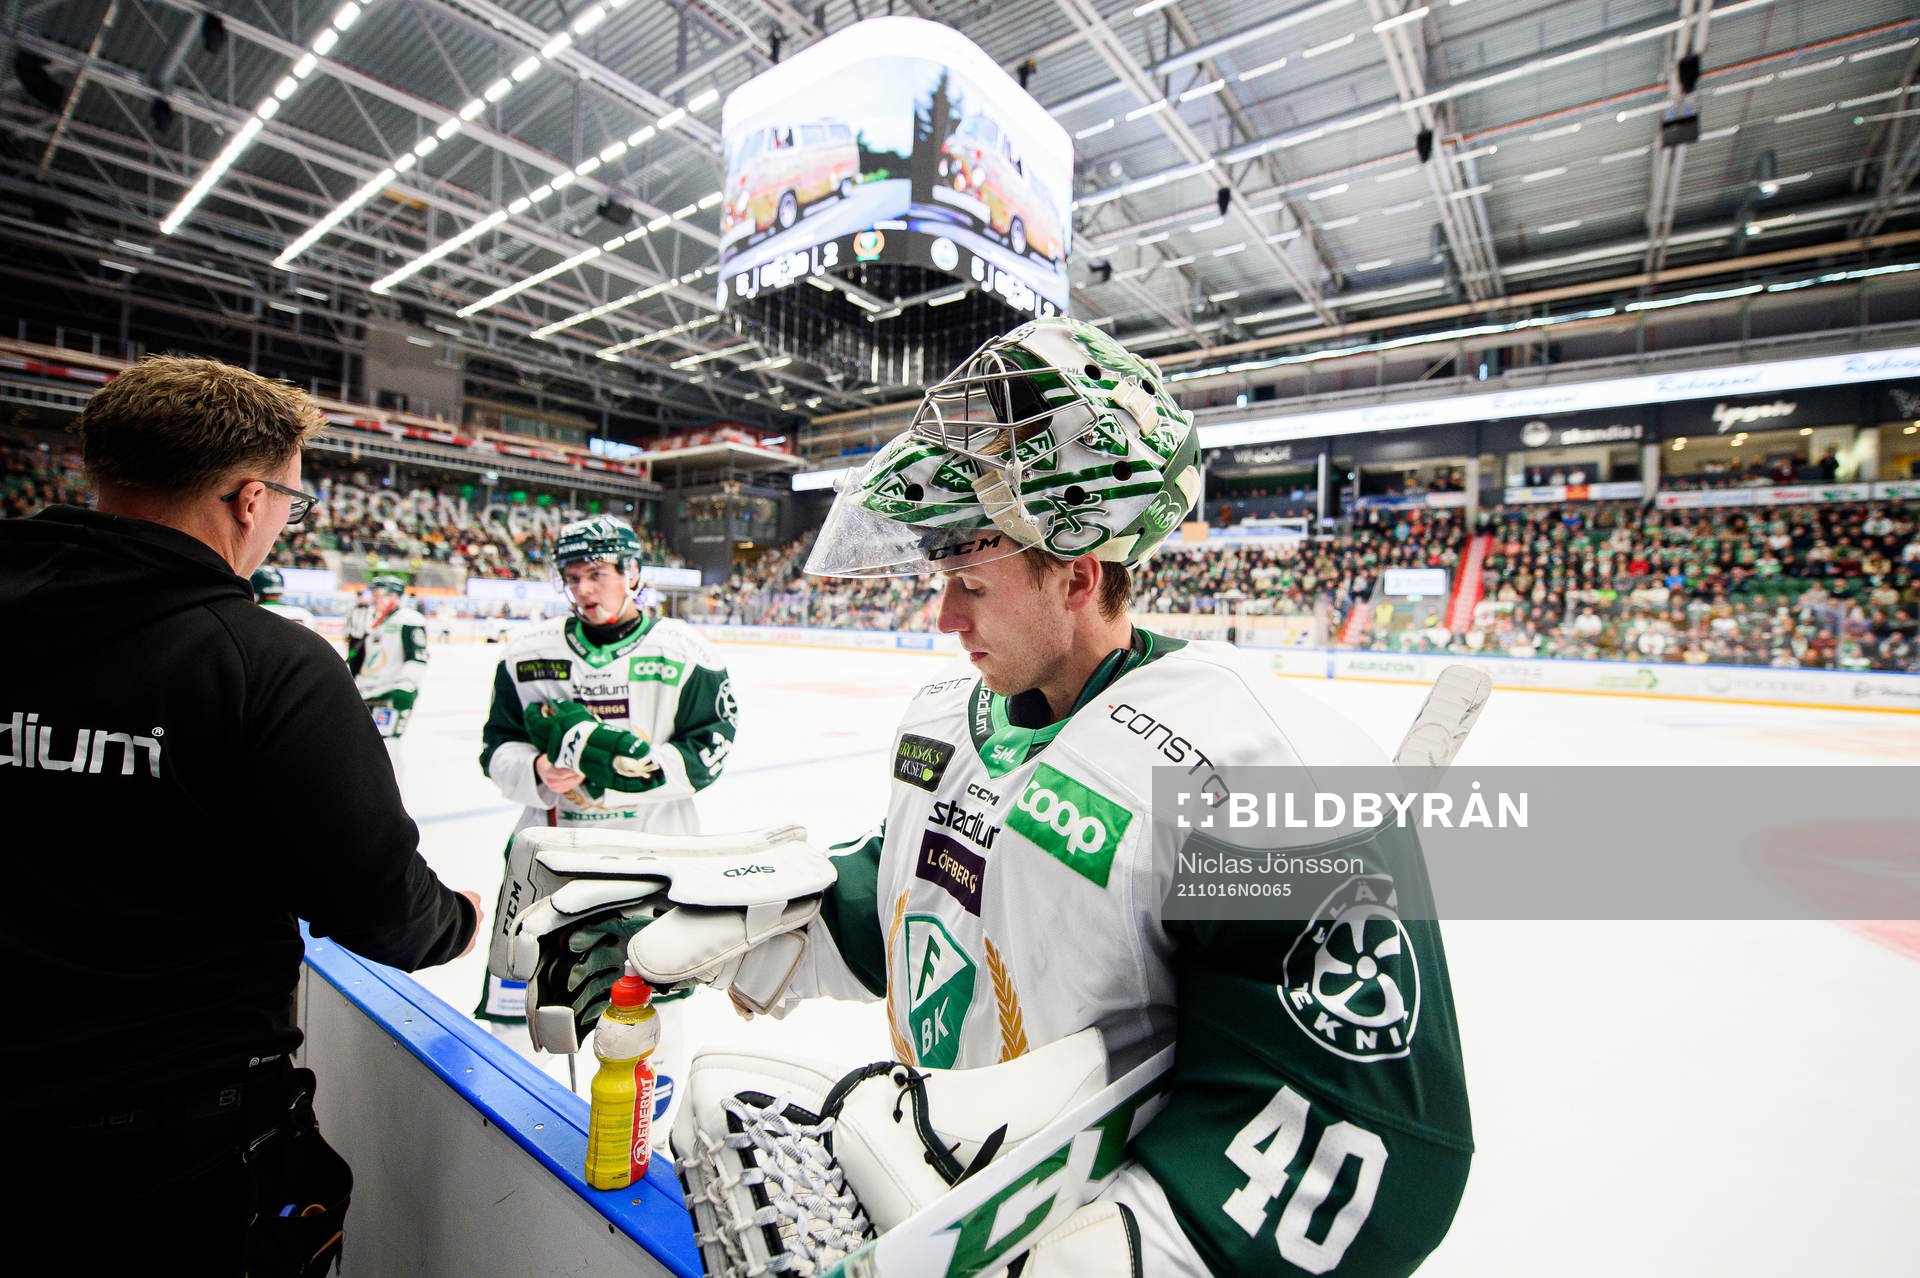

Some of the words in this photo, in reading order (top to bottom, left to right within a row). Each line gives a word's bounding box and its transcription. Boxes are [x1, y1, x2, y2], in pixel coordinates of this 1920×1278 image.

[633, 660, 679, 681] coop
[990, 744, 1017, 764] SHL
[966, 783, 1000, 806] CCM
[1016, 780, 1107, 855] coop
[1221, 1085, 1389, 1275] 40
